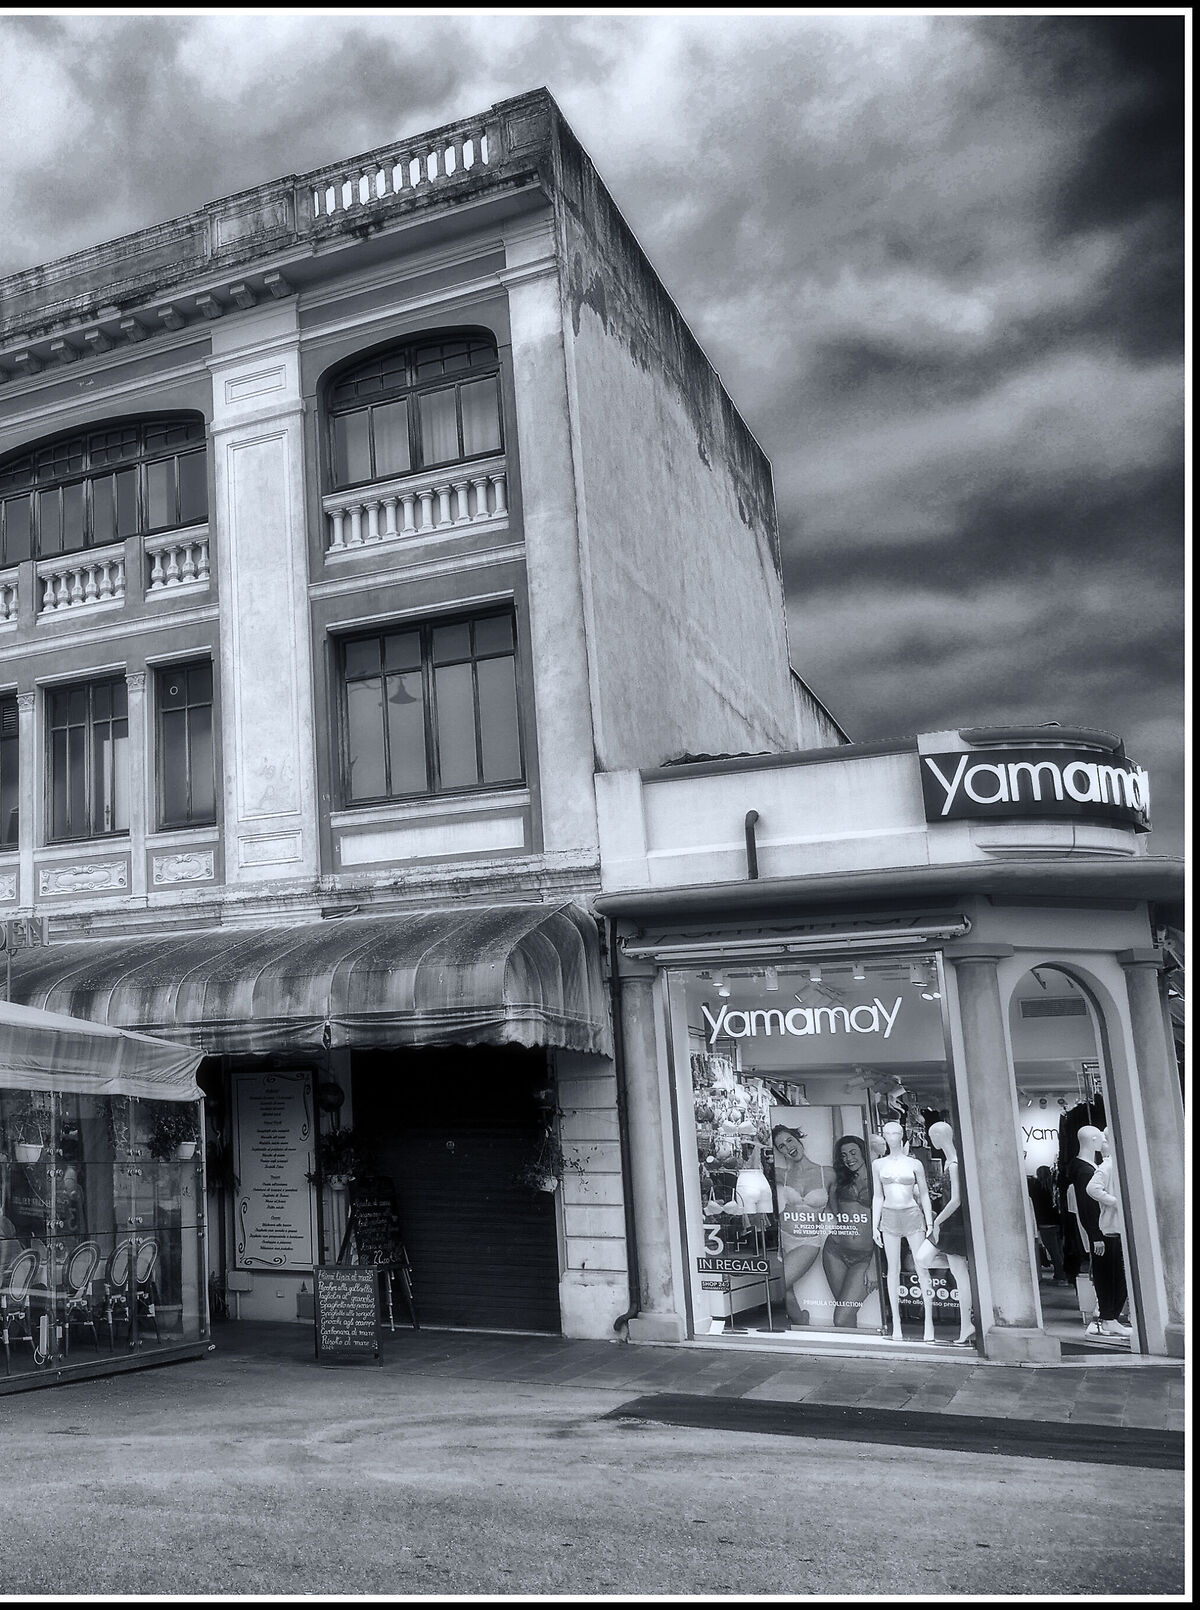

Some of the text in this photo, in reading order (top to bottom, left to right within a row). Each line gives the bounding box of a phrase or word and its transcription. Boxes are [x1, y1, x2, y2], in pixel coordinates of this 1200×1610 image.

[783, 1212, 868, 1223] PUSH UP 19.95
[699, 1258, 768, 1272] IN REGALO
